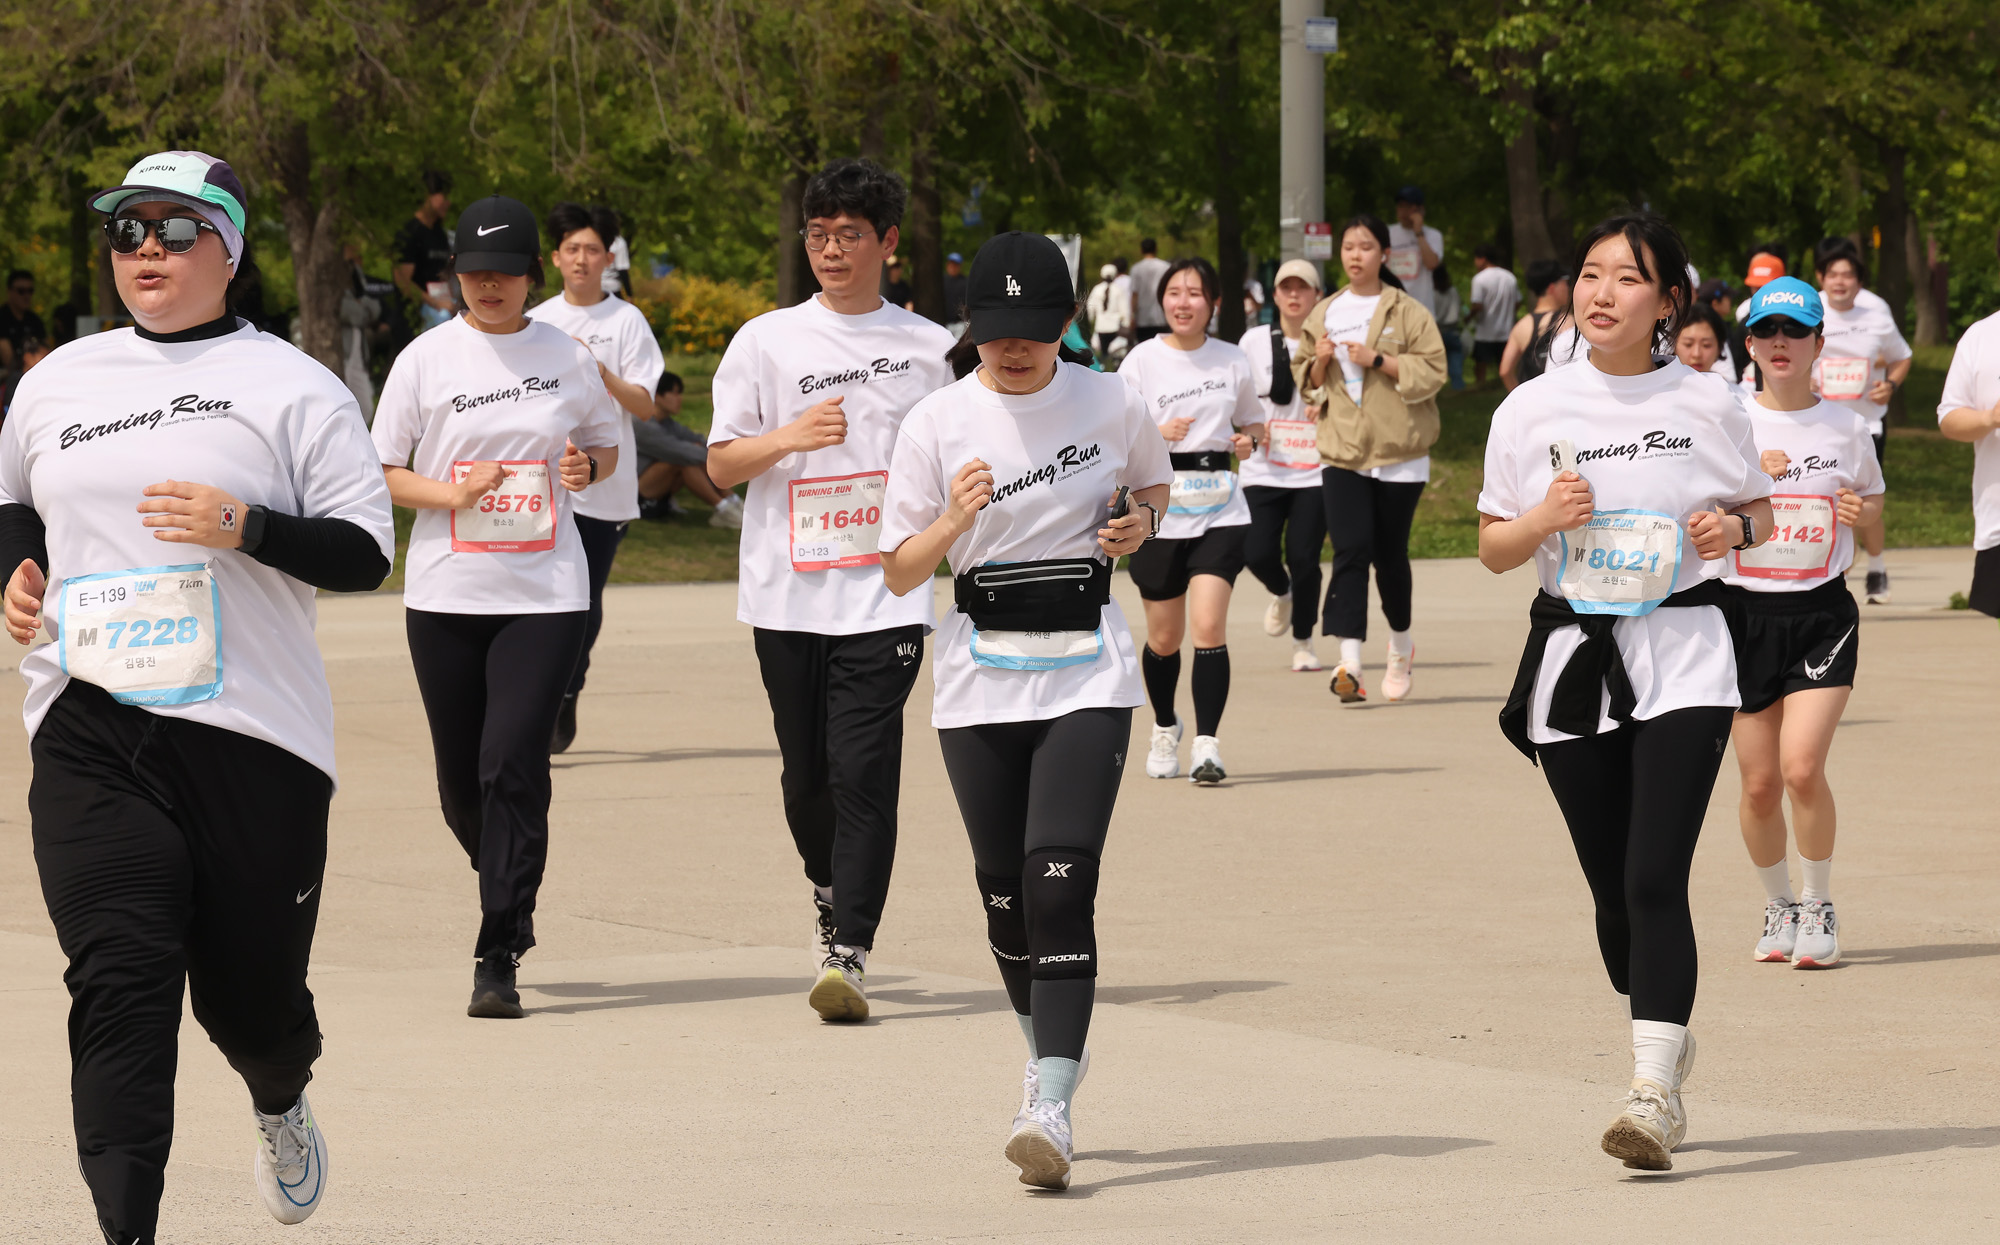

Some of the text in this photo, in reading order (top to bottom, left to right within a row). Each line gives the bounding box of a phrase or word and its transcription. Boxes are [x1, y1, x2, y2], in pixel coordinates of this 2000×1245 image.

[138, 165, 177, 174] KIPRUN
[1005, 274, 1021, 296] LA
[1761, 291, 1804, 308] HOKA
[798, 369, 870, 395] Burning
[870, 357, 911, 377] Run
[451, 387, 522, 413] Burning
[522, 376, 561, 395] Run
[1157, 379, 1227, 409] Burning Run
[59, 393, 234, 450] Burning Run
[160, 418, 180, 428] Casual
[181, 415, 206, 423] Running
[1642, 430, 1693, 453] Run
[1803, 455, 1839, 474] Run
[862, 482, 882, 490] 10km
[979, 443, 1101, 511] urning Run
[1183, 478, 1220, 491] 8041
[797, 487, 833, 498] BURNING
[834, 484, 853, 494] RUN
[479, 494, 543, 513] 3576
[1783, 503, 1802, 511] RUN
[801, 506, 880, 530] M 1640
[1612, 518, 1636, 528] RUN
[1652, 521, 1672, 531] 7km
[798, 547, 829, 557] D-123
[1574, 547, 1660, 573] W 8021
[178, 578, 203, 590] 7km
[79, 586, 127, 607] E-139
[77, 616, 199, 650] M 7228
[896, 642, 917, 658] NIKE
